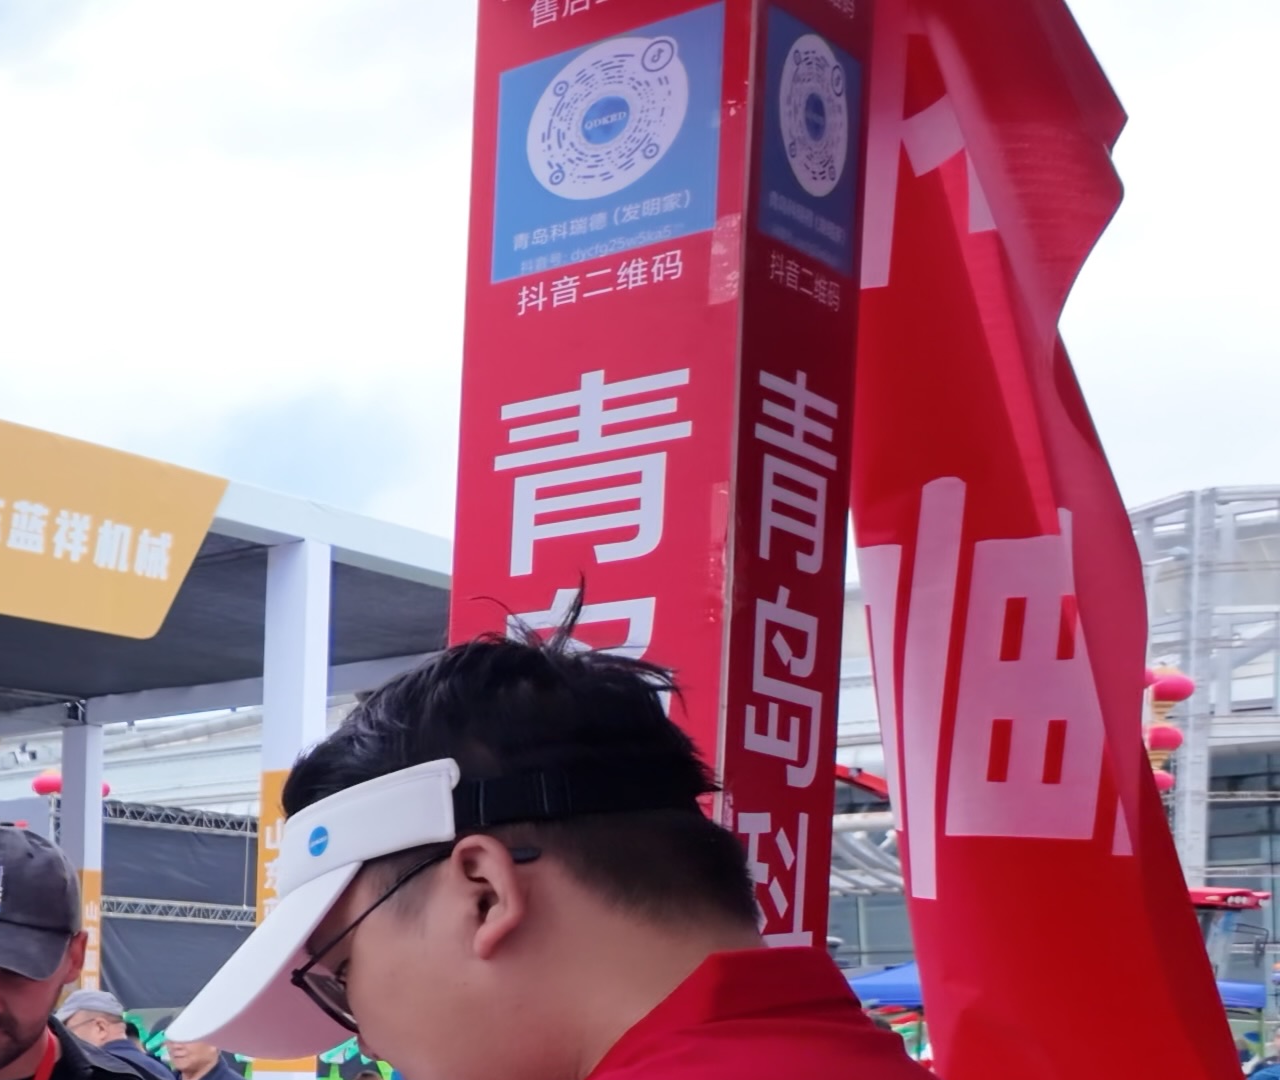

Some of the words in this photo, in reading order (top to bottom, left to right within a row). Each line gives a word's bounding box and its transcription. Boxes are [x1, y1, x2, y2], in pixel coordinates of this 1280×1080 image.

[516, 249, 684, 316] 抖音二维码
